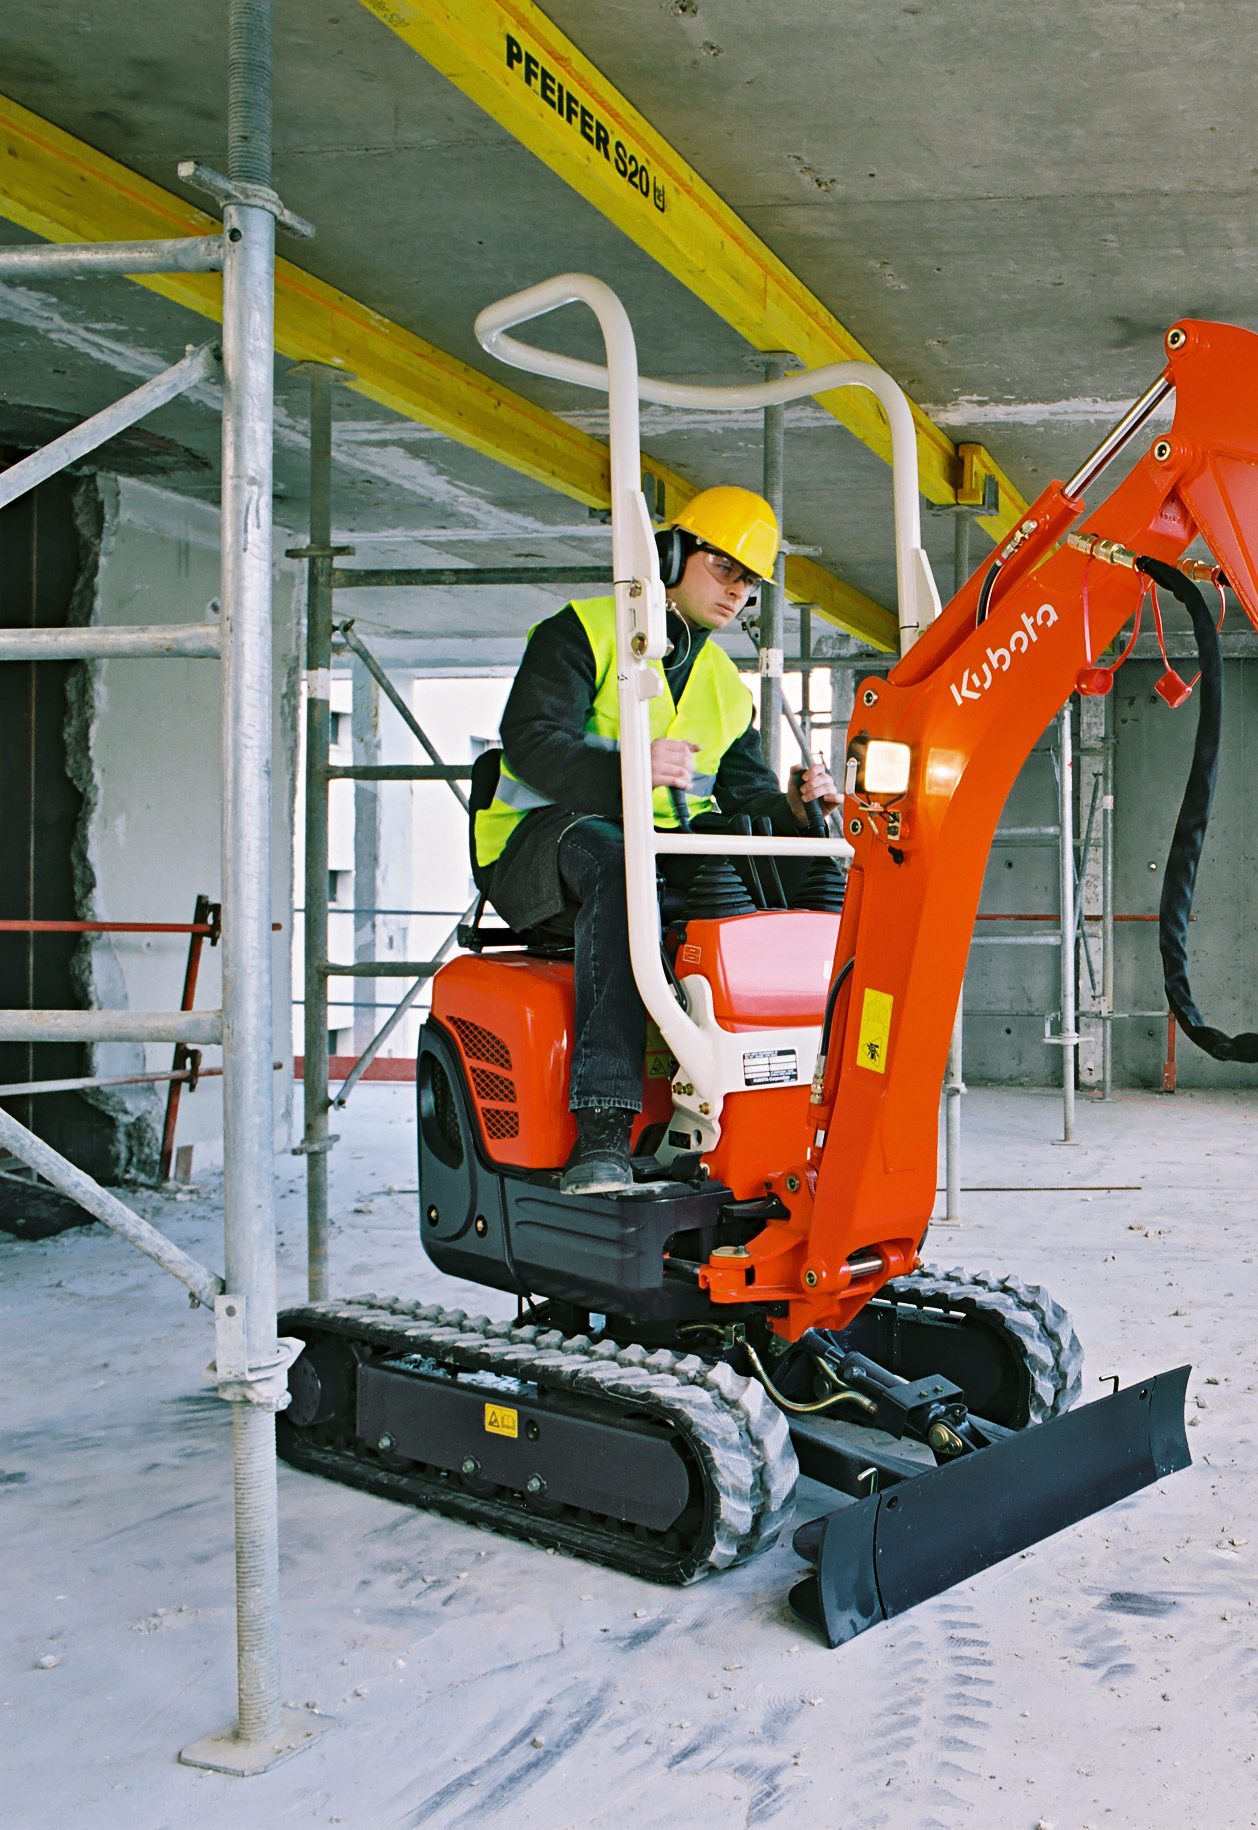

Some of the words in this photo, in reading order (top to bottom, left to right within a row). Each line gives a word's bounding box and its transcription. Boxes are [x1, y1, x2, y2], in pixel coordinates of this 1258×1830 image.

[506, 32, 610, 162] PFEIFER
[614, 140, 650, 198] S20
[949, 603, 1059, 706] Kubota
